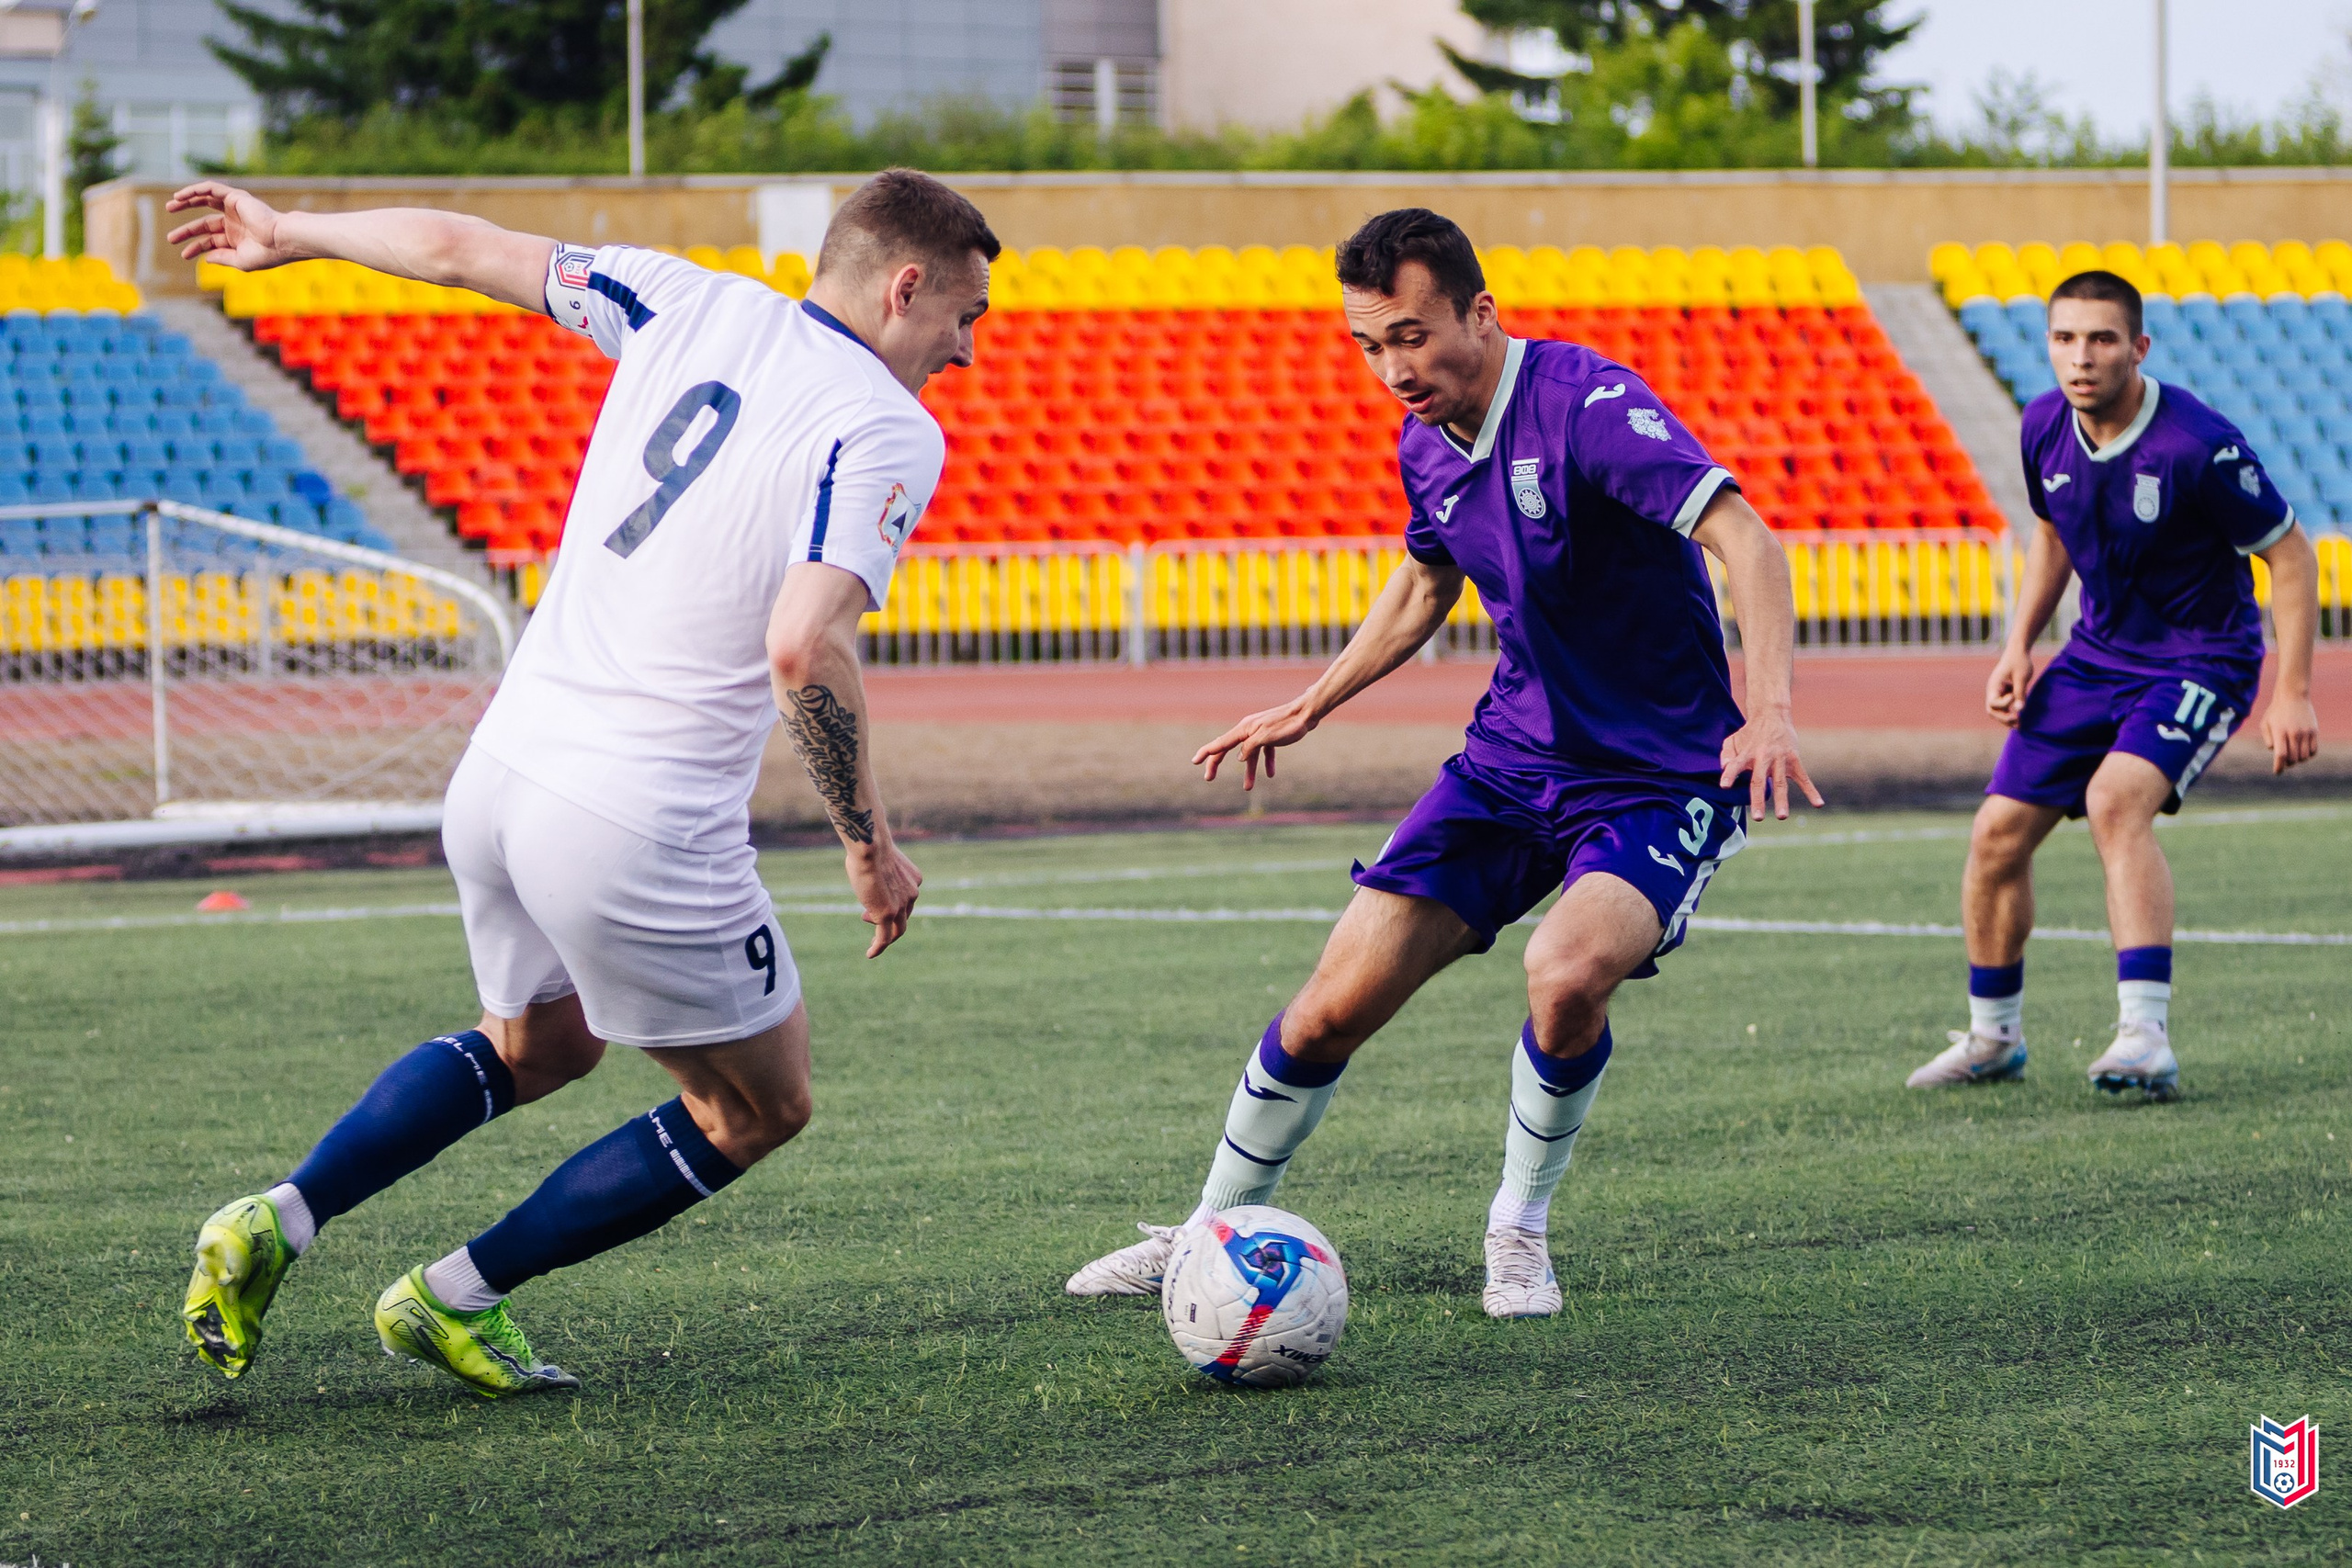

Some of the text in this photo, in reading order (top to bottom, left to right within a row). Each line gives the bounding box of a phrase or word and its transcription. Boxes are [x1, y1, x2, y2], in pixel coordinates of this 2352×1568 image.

[604, 379, 741, 559] 9
[2174, 679, 2217, 731] 11
[744, 923, 776, 998] 9
[1270, 1344, 1330, 1364] EMIX
